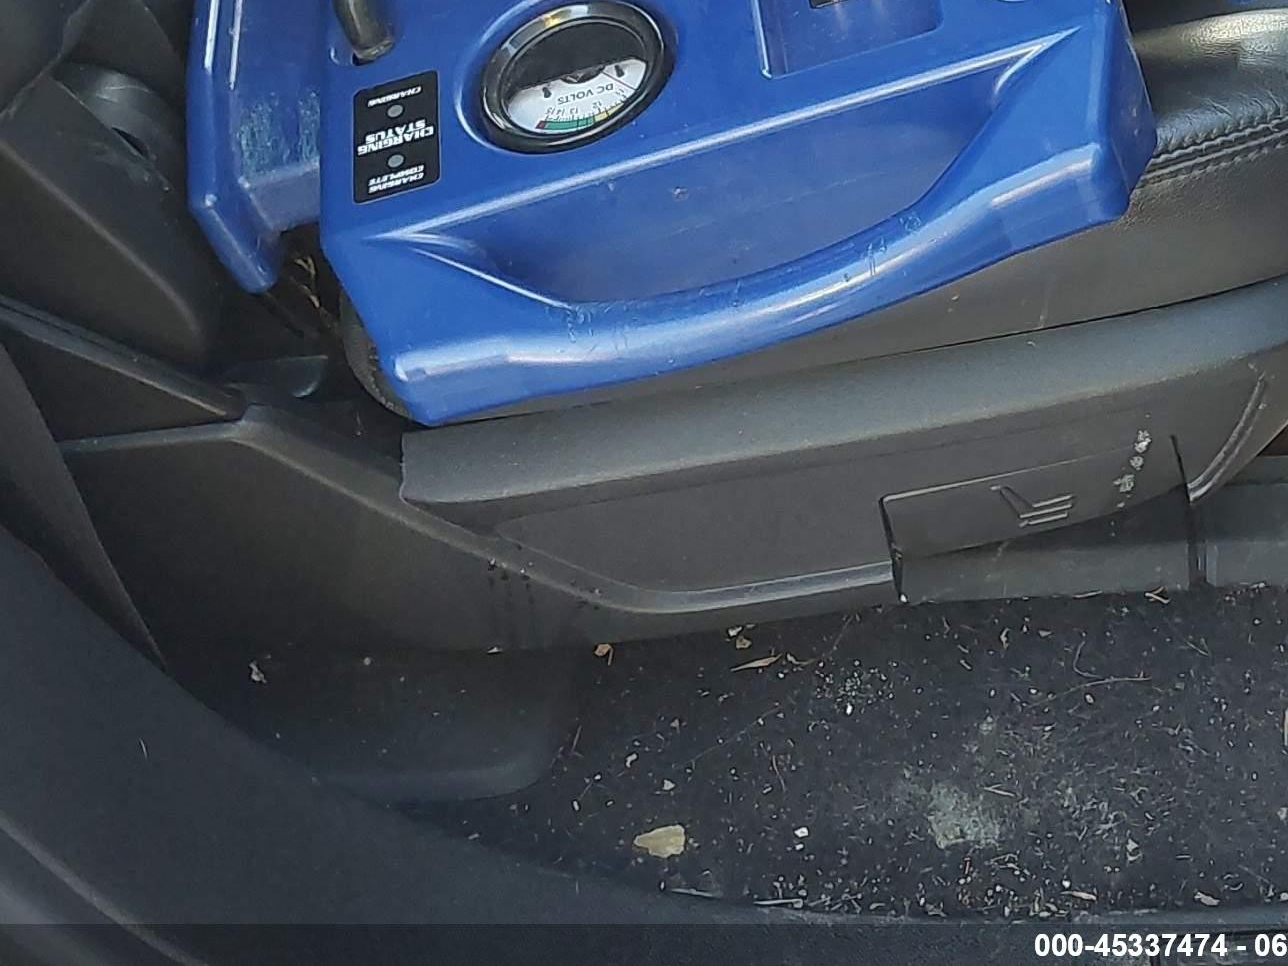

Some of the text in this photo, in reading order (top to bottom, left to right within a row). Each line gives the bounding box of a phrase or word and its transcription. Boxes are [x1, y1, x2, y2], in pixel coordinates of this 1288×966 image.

[367, 86, 422, 108] CHARGING
[557, 83, 614, 105] DC VOLTS
[357, 126, 434, 156] CHARGING
[365, 119, 426, 144] STATUS
[368, 165, 424, 186] COMPLETE
[368, 172, 424, 194] CHARGING
